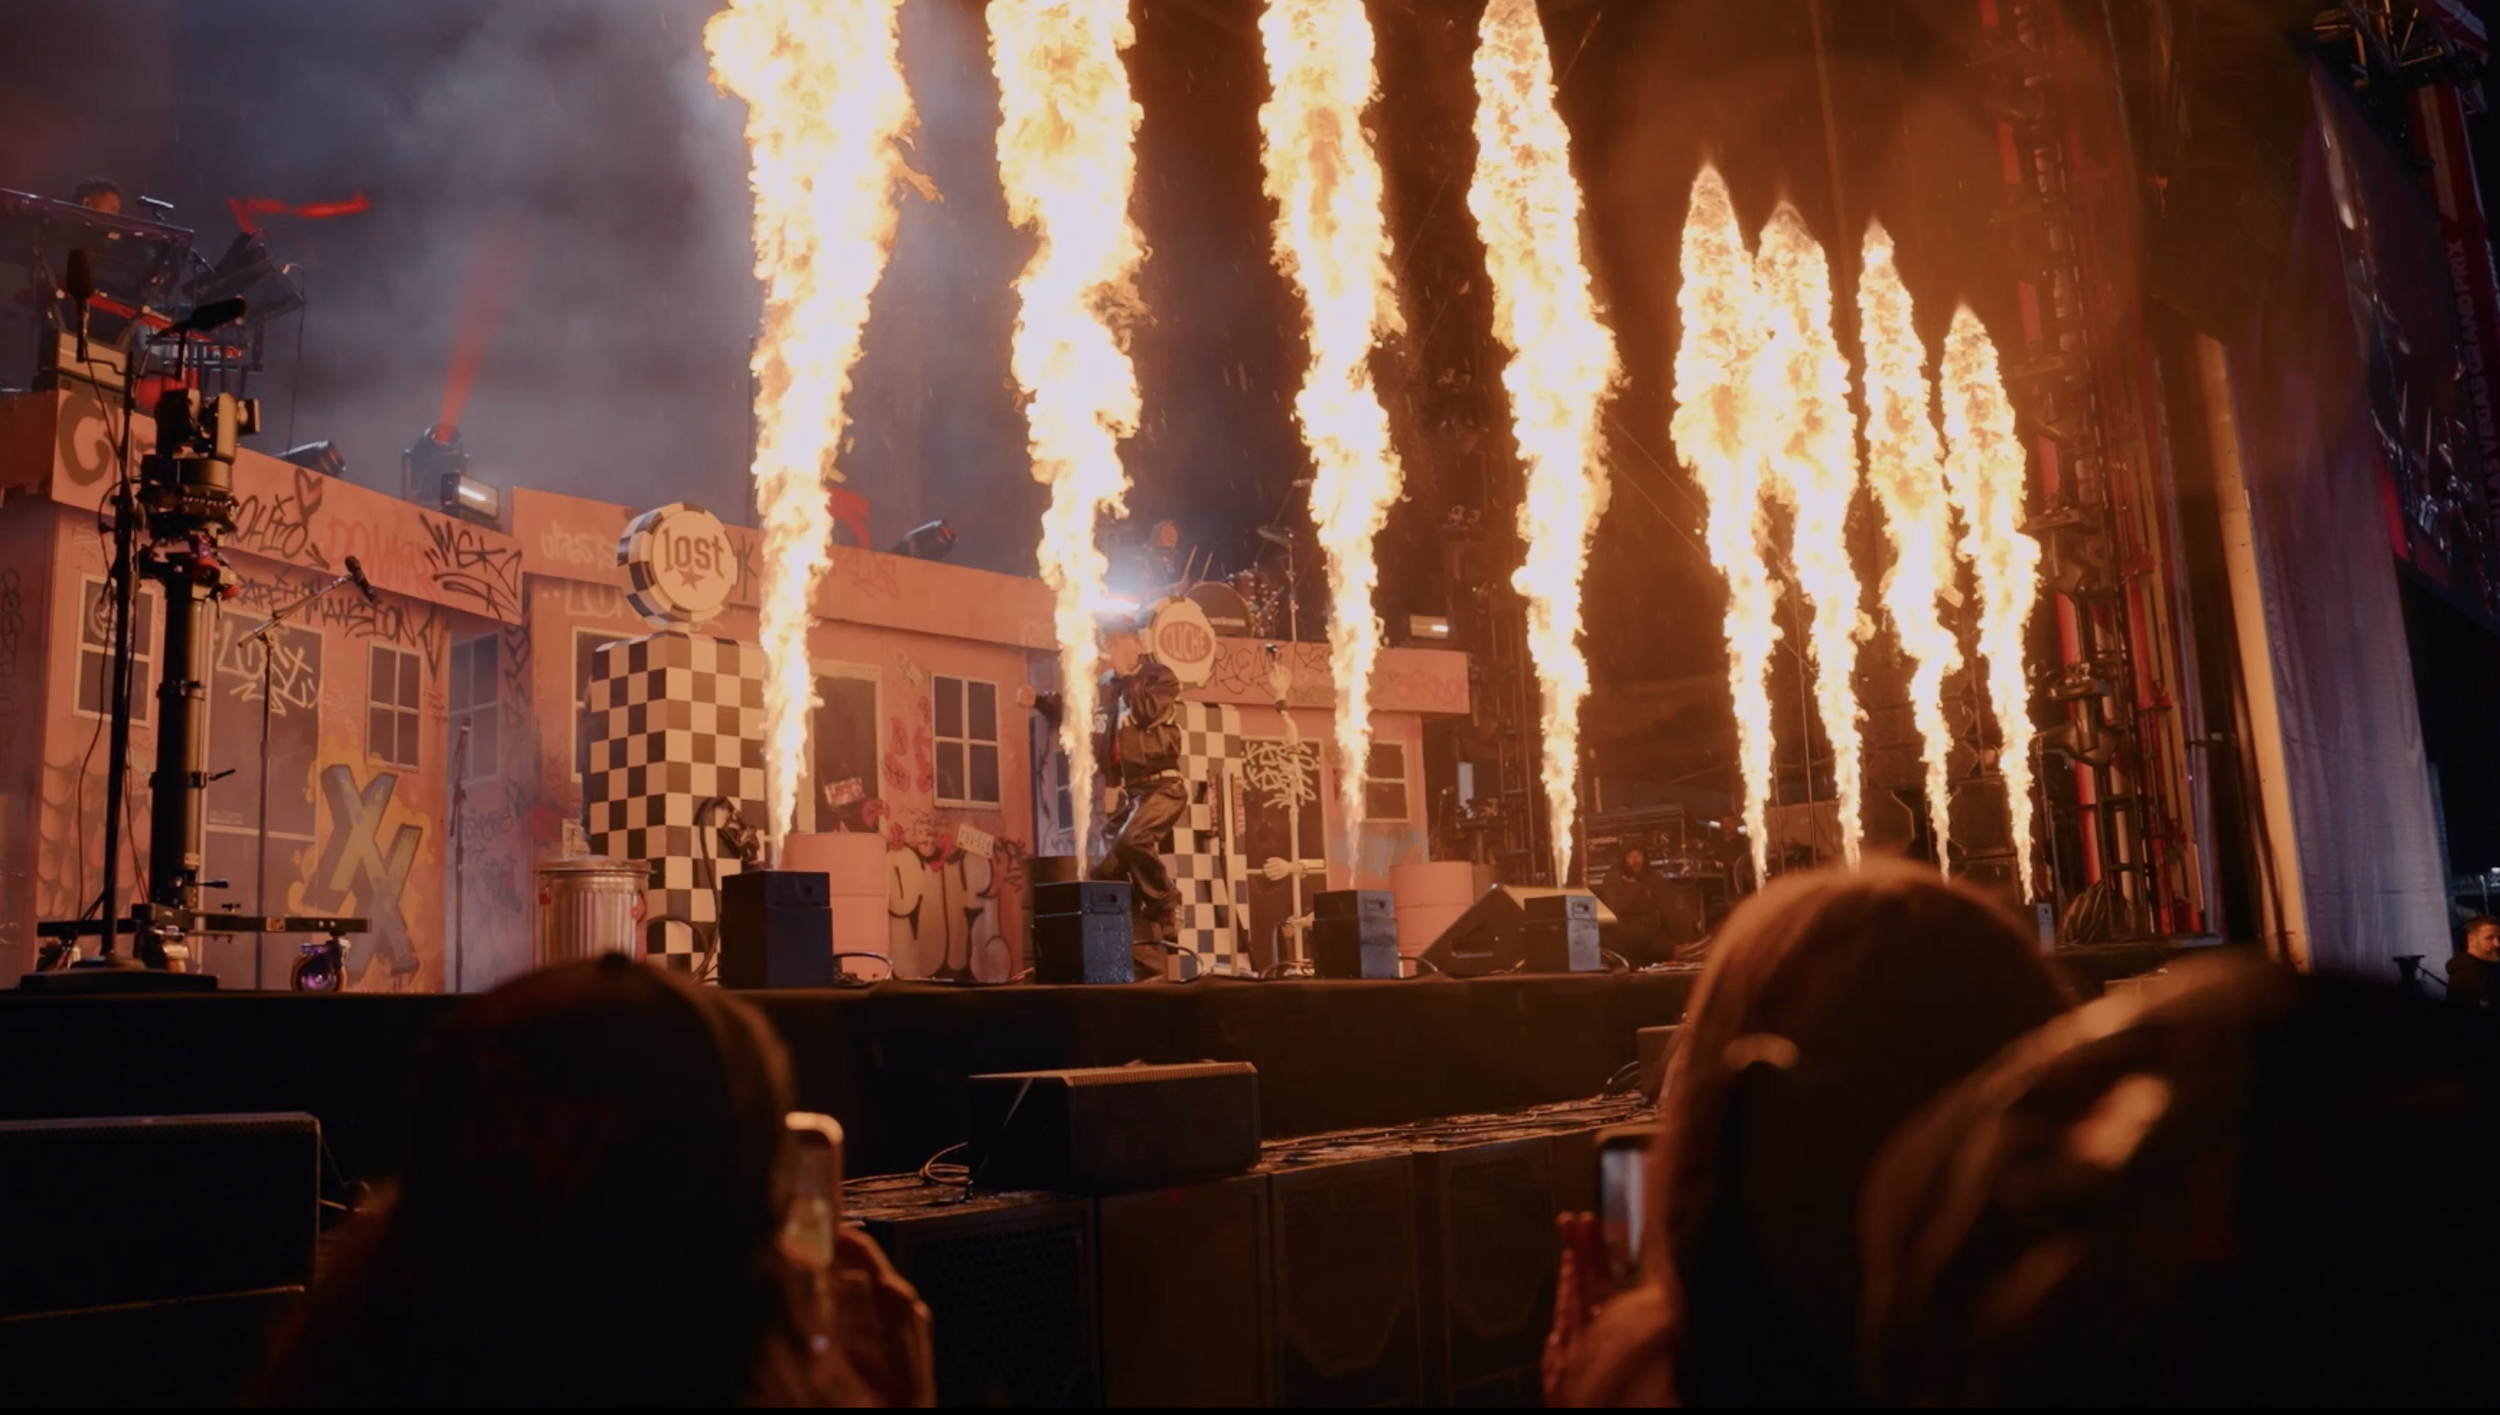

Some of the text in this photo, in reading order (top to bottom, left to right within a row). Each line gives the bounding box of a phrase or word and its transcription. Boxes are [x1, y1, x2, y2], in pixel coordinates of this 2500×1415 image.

[2448, 239, 2471, 292] PRIX
[2457, 294, 2483, 373] GRAND
[2470, 376, 2498, 454] VEGAS
[662, 527, 725, 580] lost
